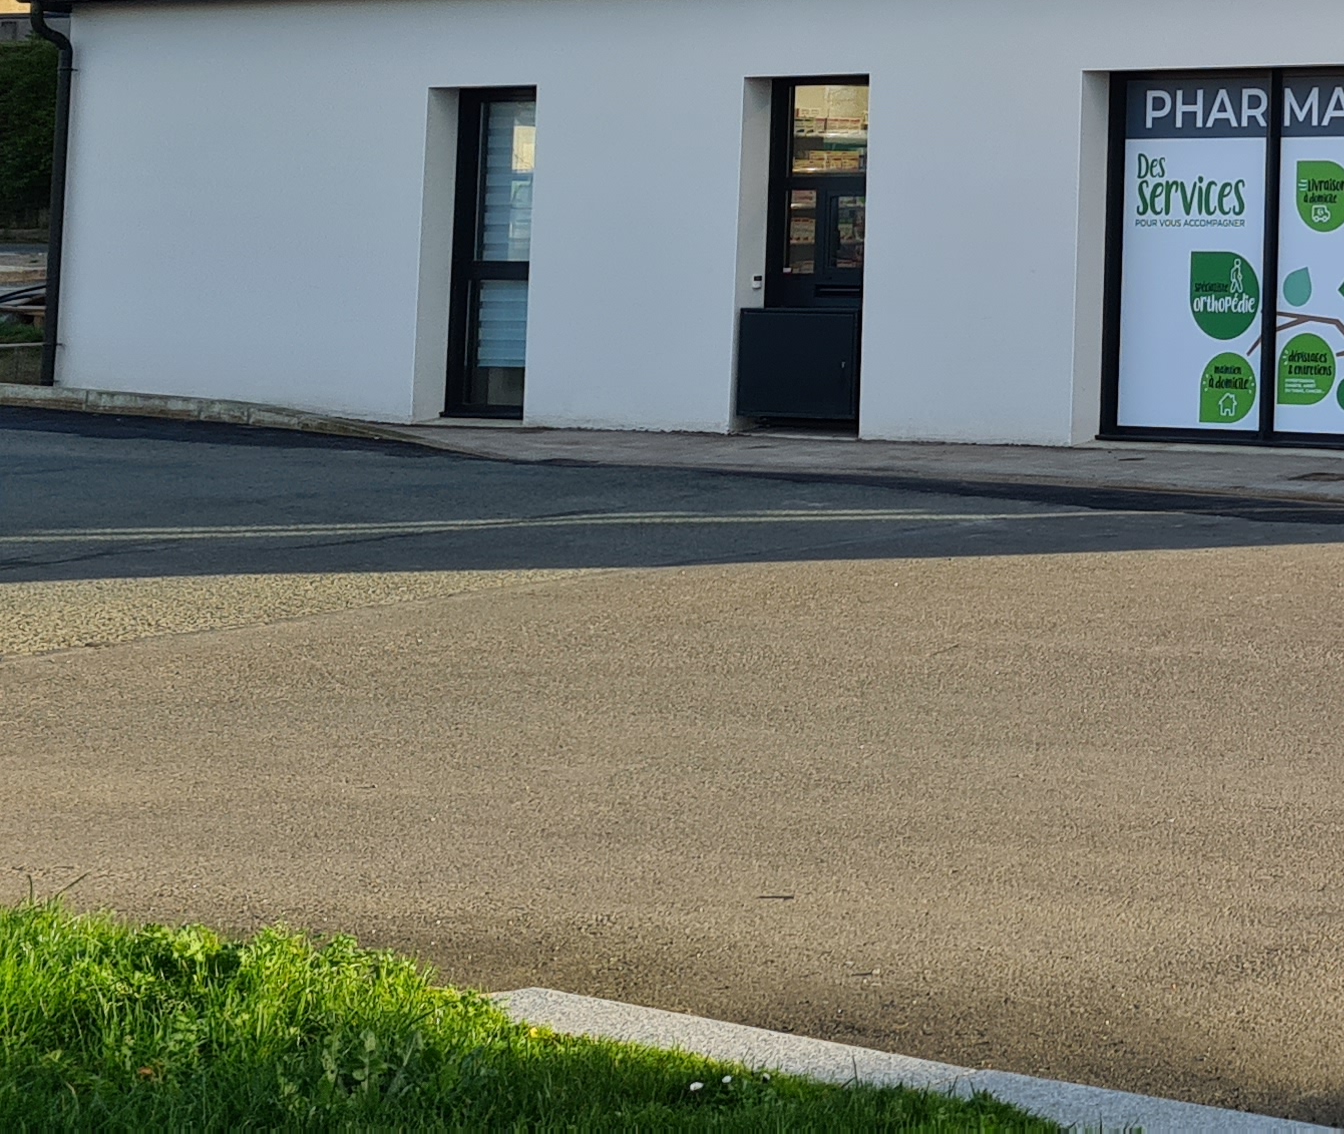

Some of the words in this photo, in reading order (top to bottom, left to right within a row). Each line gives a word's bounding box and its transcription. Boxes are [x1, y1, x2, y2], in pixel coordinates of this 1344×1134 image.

[1137, 153, 1166, 179] Des
[1136, 176, 1245, 216] services
[1135, 219, 1157, 227] POUR
[1160, 219, 1181, 227] VOUS
[1183, 219, 1245, 227] ACCOMPAGNER
[1193, 293, 1255, 313] orthopédie
[1215, 375, 1249, 389] domicile
